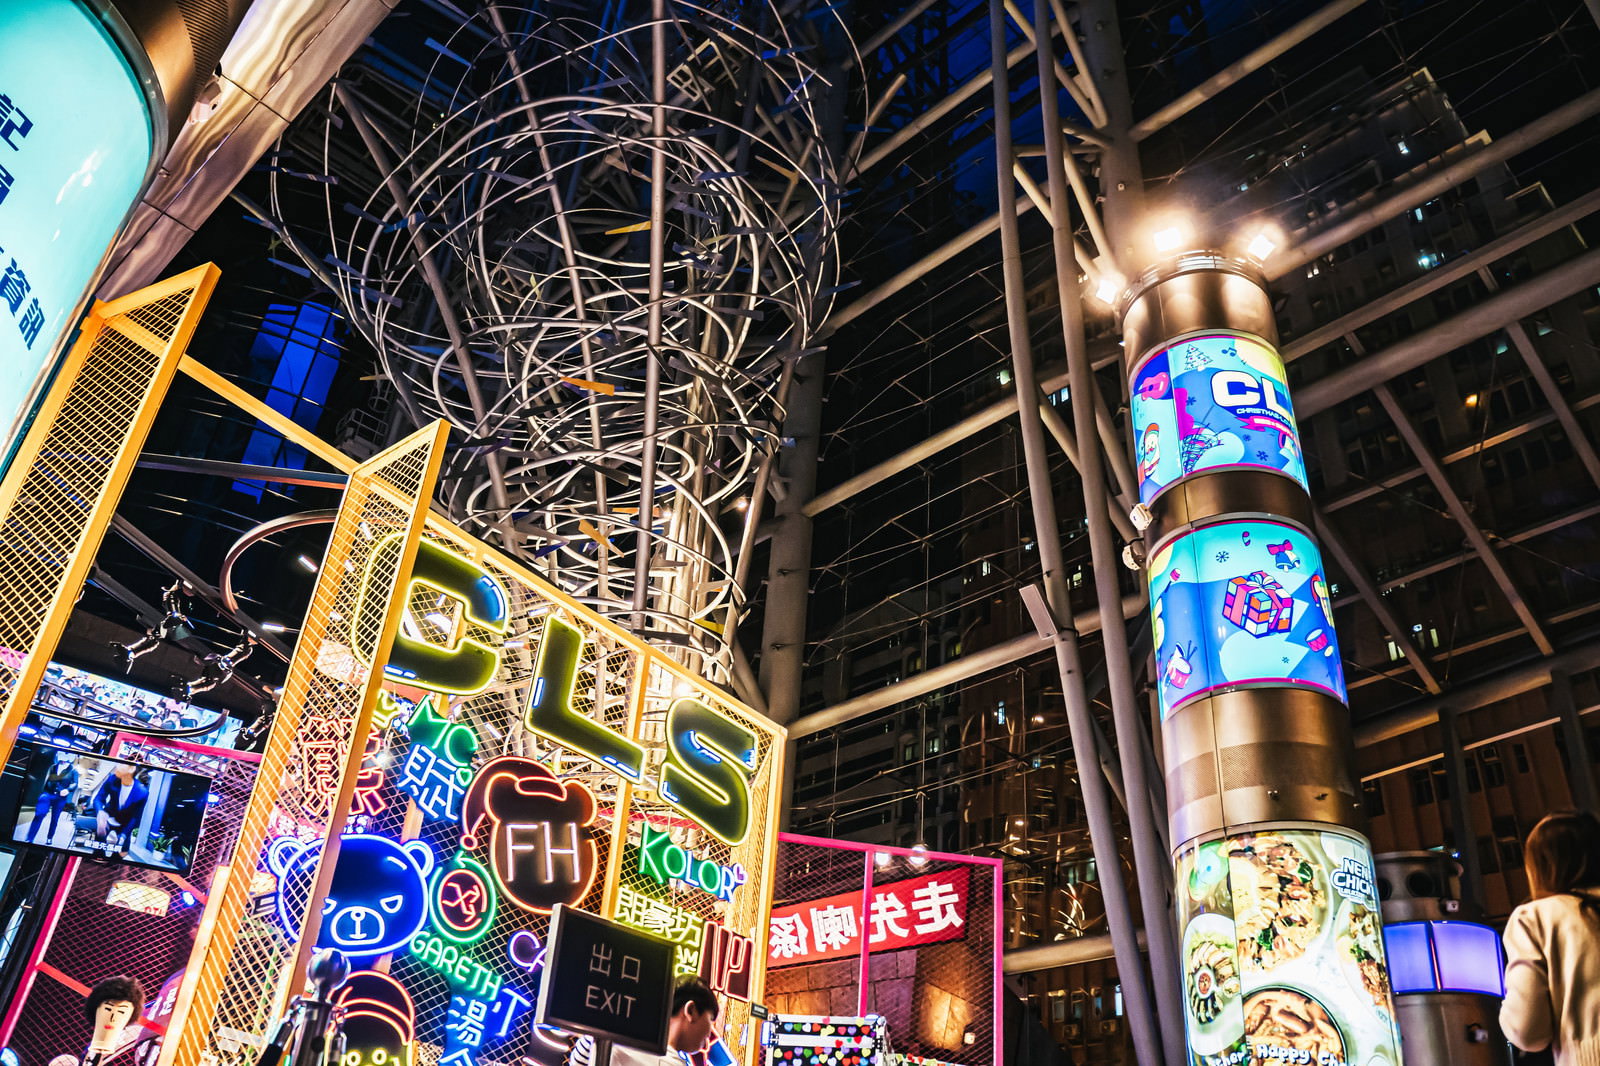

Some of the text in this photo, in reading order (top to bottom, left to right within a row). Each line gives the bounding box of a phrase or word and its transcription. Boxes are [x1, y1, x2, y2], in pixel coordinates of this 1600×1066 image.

[352, 529, 758, 848] CLS
[407, 694, 479, 767] MC
[505, 821, 581, 884] FH
[1343, 858, 1372, 882] NEN
[614, 885, 704, 948] 朗豪坊
[589, 942, 641, 983] 出口
[585, 984, 637, 1018] EXIT
